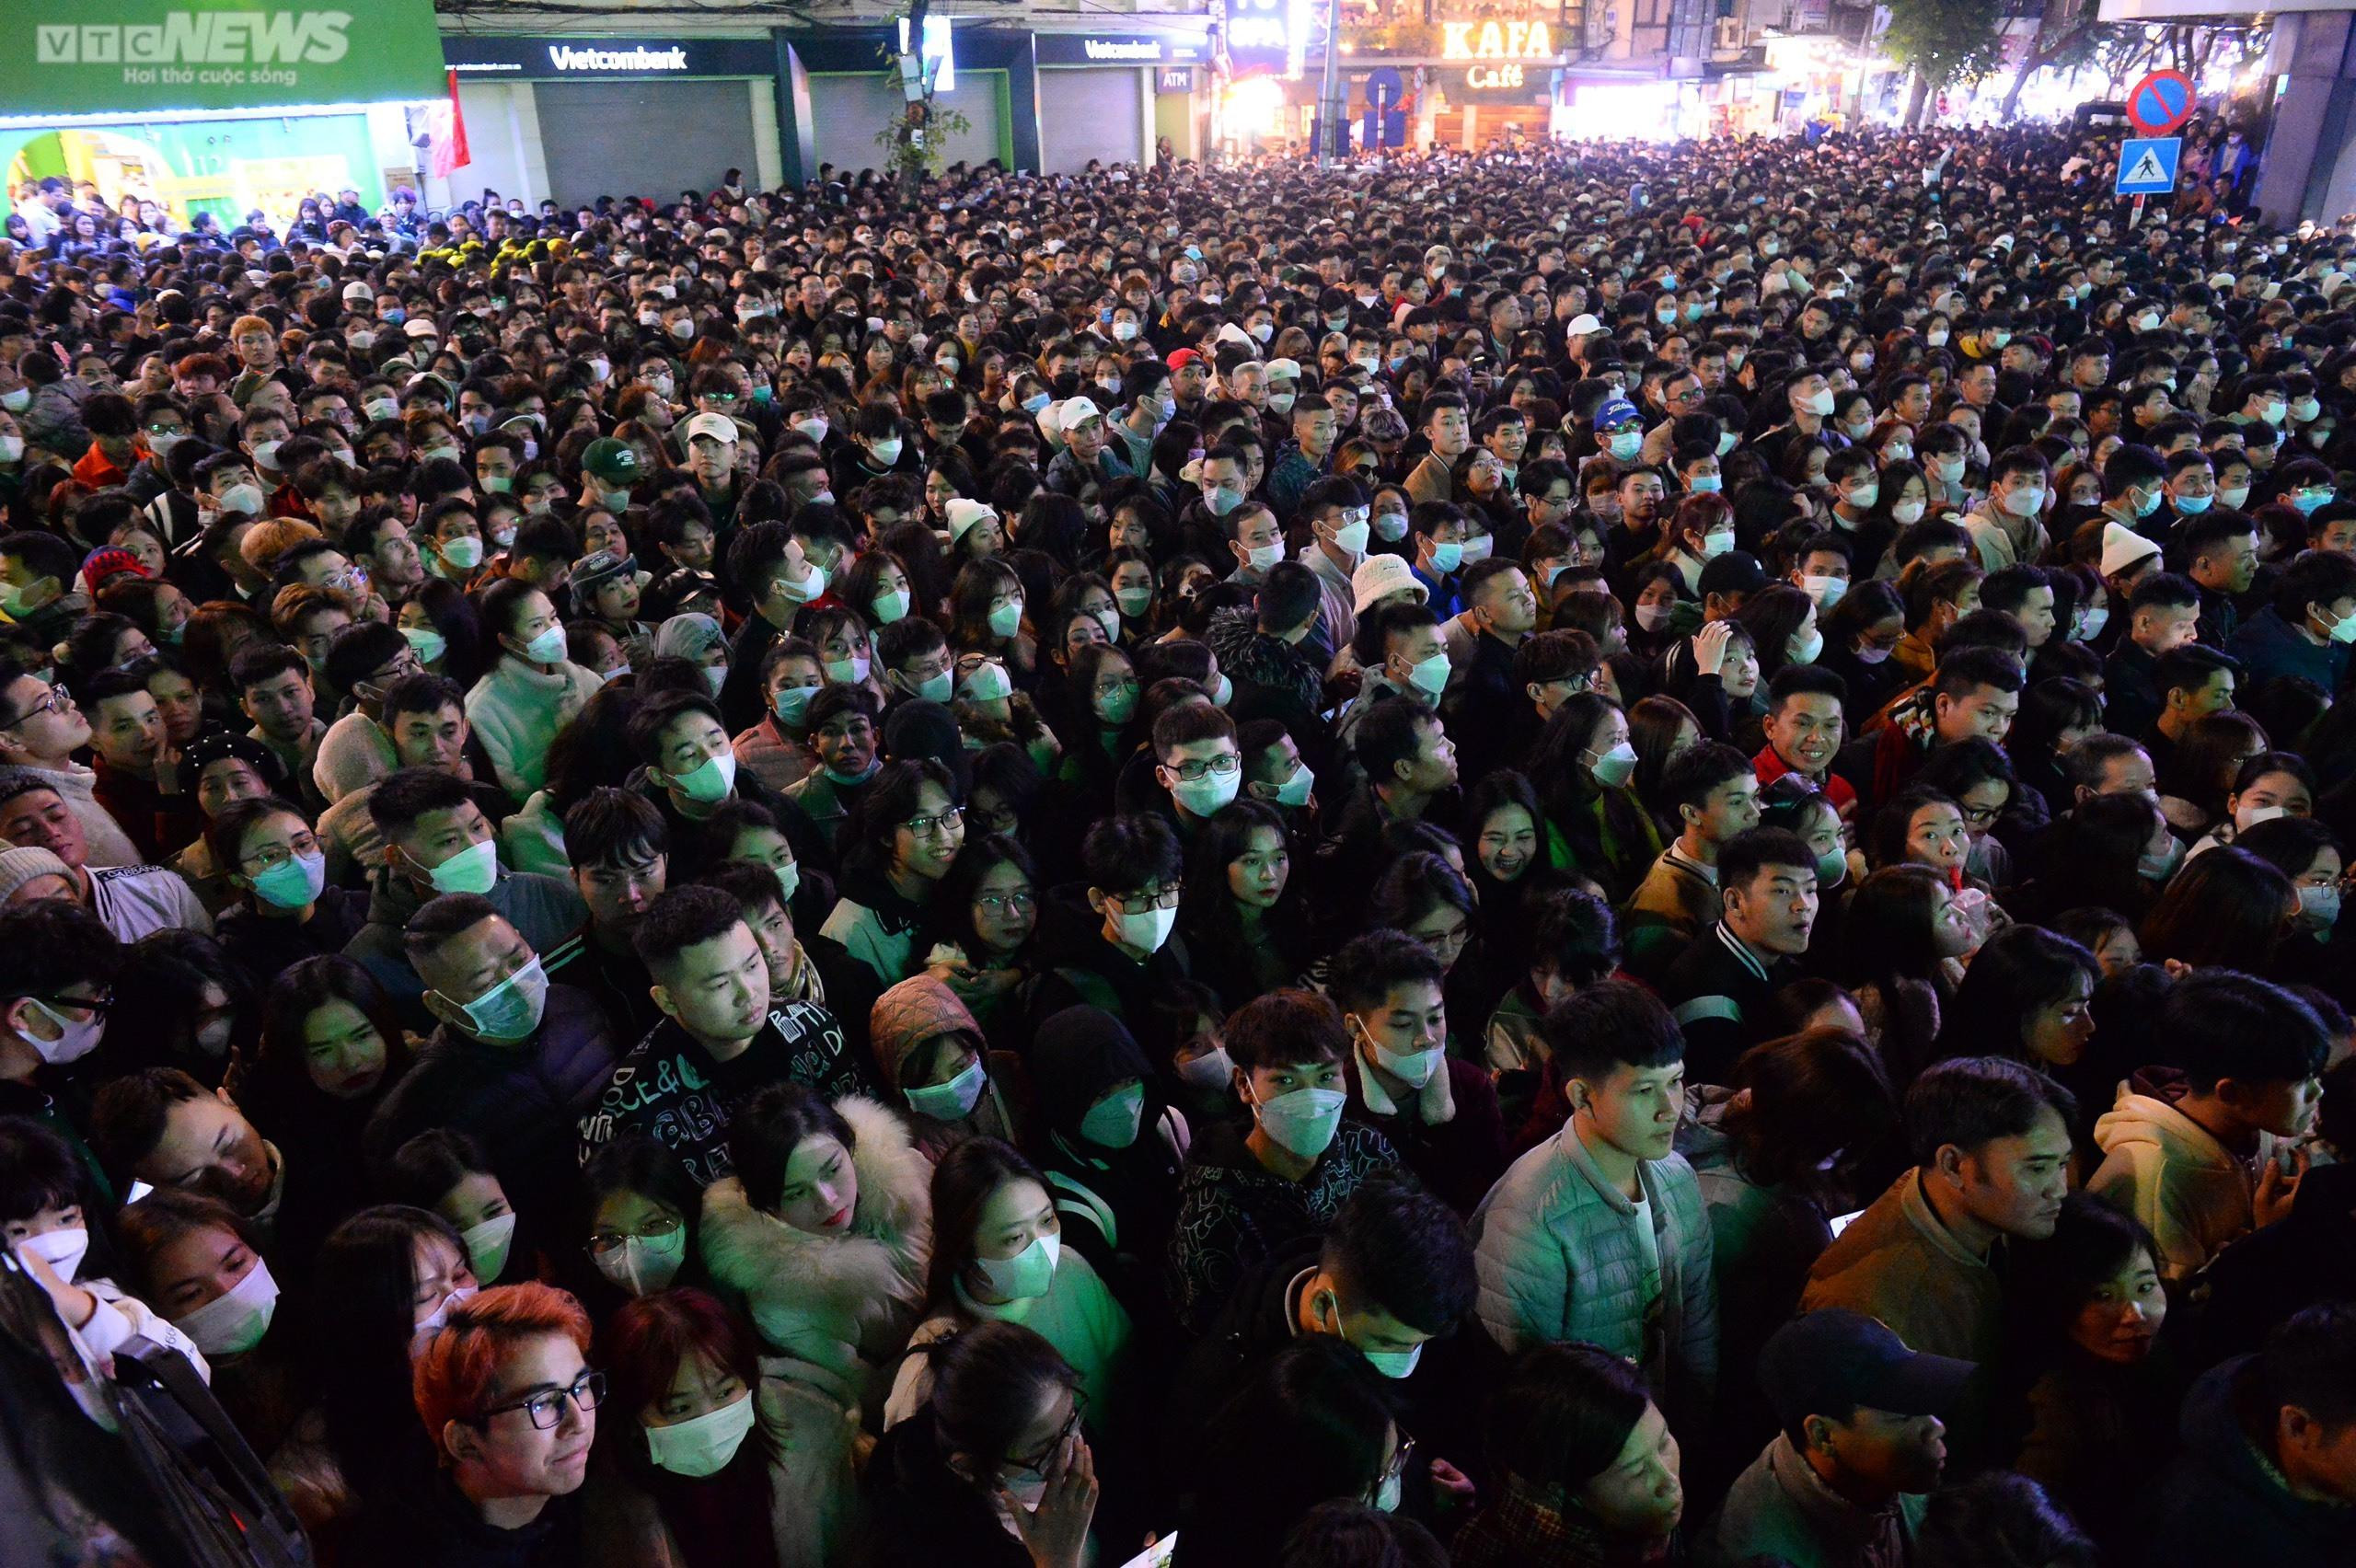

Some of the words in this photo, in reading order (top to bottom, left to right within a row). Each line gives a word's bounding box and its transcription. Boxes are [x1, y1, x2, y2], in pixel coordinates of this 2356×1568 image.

[1442, 20, 1553, 59] KAFA
[549, 45, 688, 70] Vietcombank
[1162, 72, 1187, 86] ATM
[1466, 63, 1524, 88] Café
